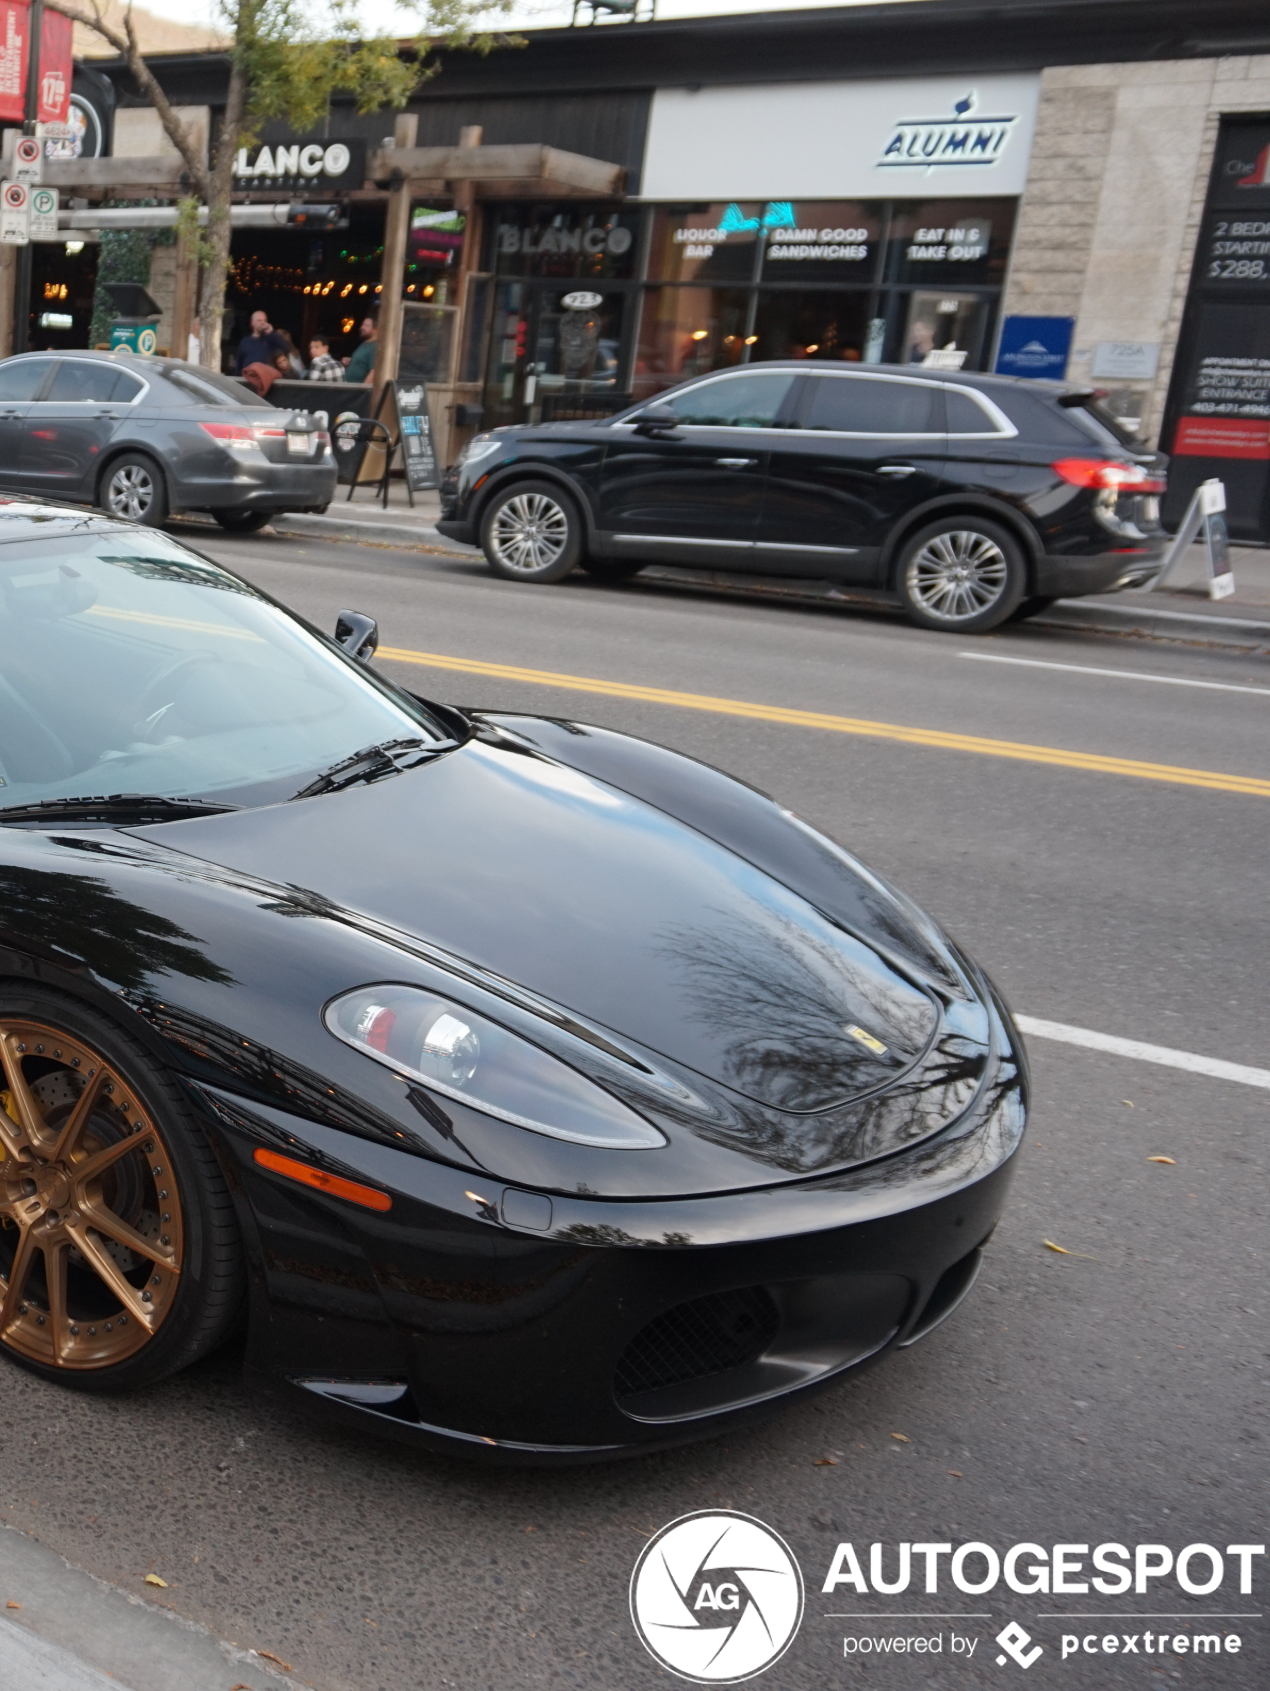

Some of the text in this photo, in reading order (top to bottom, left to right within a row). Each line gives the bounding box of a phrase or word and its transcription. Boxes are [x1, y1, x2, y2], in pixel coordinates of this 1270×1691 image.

[5, 9, 16, 93] ENTERTAINMENT
[12, 49, 21, 94] DISTRICT
[885, 129, 1009, 157] ALUMNI
[232, 143, 350, 177] LANCO
[675, 228, 728, 242] LIQUOR
[773, 228, 868, 242] DAMN GOOD
[916, 228, 945, 242] EAT
[947, 228, 965, 242] IN
[1215, 221, 1228, 235] 2
[502, 226, 632, 254] BLANCO
[685, 244, 714, 258] BAR
[770, 244, 868, 259] SANDWICHES
[909, 245, 982, 259] TAKE OUT
[1198, 376, 1270, 389] SHOW SUIT
[1201, 388, 1269, 400] ENTRANCE
